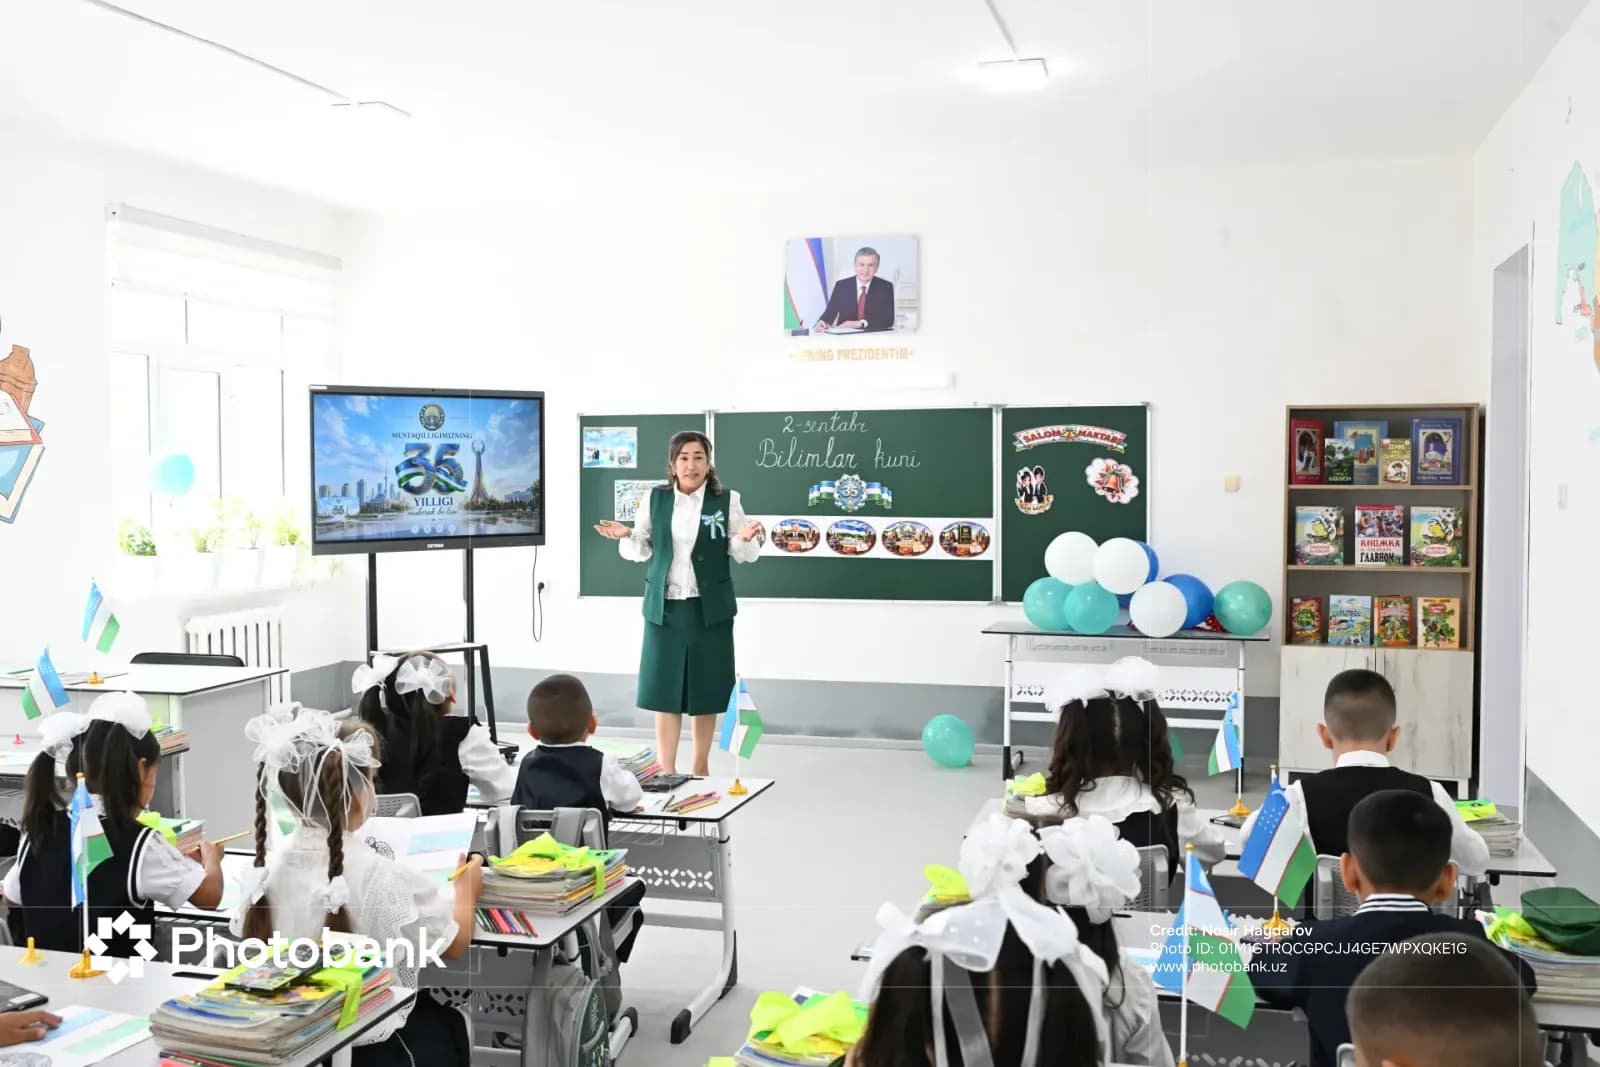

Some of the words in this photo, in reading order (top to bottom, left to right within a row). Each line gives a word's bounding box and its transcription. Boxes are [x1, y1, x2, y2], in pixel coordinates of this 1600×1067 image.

[837, 346, 909, 361] PREZIDENTIM
[392, 432, 473, 441] MUSTAQILLIGIMIZNING
[1023, 429, 1061, 443] SALOM
[755, 436, 858, 469] Bilimlar
[874, 437, 921, 469] kuni
[395, 443, 468, 496] 35
[414, 496, 454, 507] YILLIGI
[1360, 539, 1401, 547] КНИЖКА
[1360, 552, 1394, 563] ГЛАВНОМ
